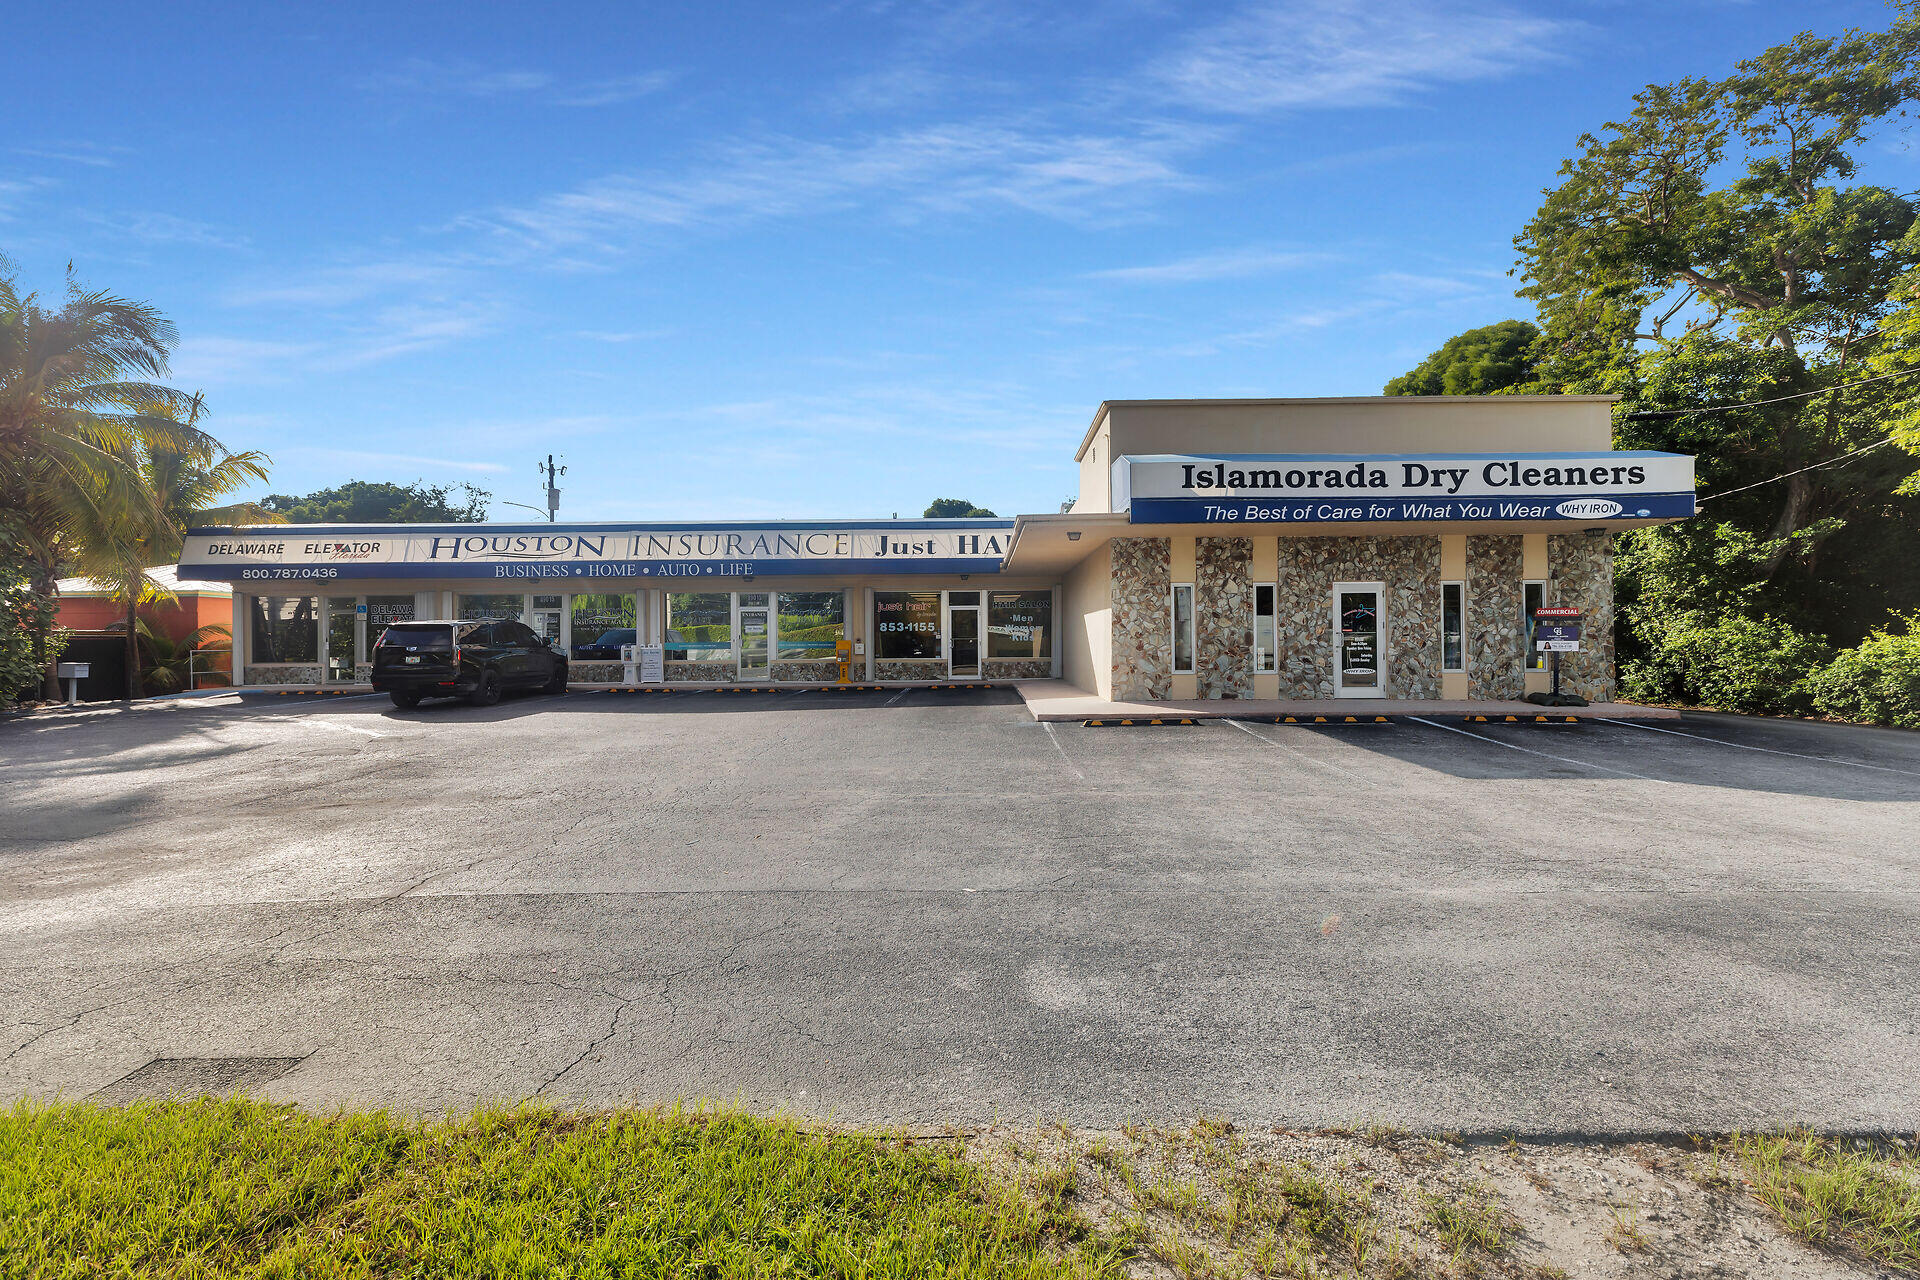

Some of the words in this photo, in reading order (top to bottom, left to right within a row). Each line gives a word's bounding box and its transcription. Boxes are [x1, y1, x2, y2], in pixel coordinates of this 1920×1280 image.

[1181, 463, 1388, 489] Islamorada
[1401, 463, 1469, 494] Dry
[1482, 461, 1646, 487] Cleaners
[1203, 505, 1238, 520] The
[1245, 505, 1288, 520] Best
[1293, 504, 1312, 519] of
[1317, 504, 1363, 519] Care
[1368, 503, 1396, 519] for
[1402, 503, 1452, 518] What
[1458, 503, 1493, 518] You
[1499, 502, 1551, 518] Wear
[1561, 504, 1587, 514] WHY
[1589, 503, 1618, 514] IRON
[207, 543, 285, 555] DELAWARE
[429, 535, 607, 560] HOUSTON
[632, 533, 849, 557] INSURANCE
[874, 535, 937, 557] Just
[242, 568, 338, 579] 800.787.0436
[495, 564, 569, 578] BUSINESS
[588, 563, 637, 577] HOME
[657, 562, 700, 577] AUTO
[719, 562, 754, 576] LIFE
[877, 601, 903, 612] just
[905, 601, 931, 611] hair
[993, 601, 1017, 609] HAIR
[1019, 600, 1051, 609] SALON
[1012, 614, 1034, 622] Men
[879, 622, 936, 632] 853-1155
